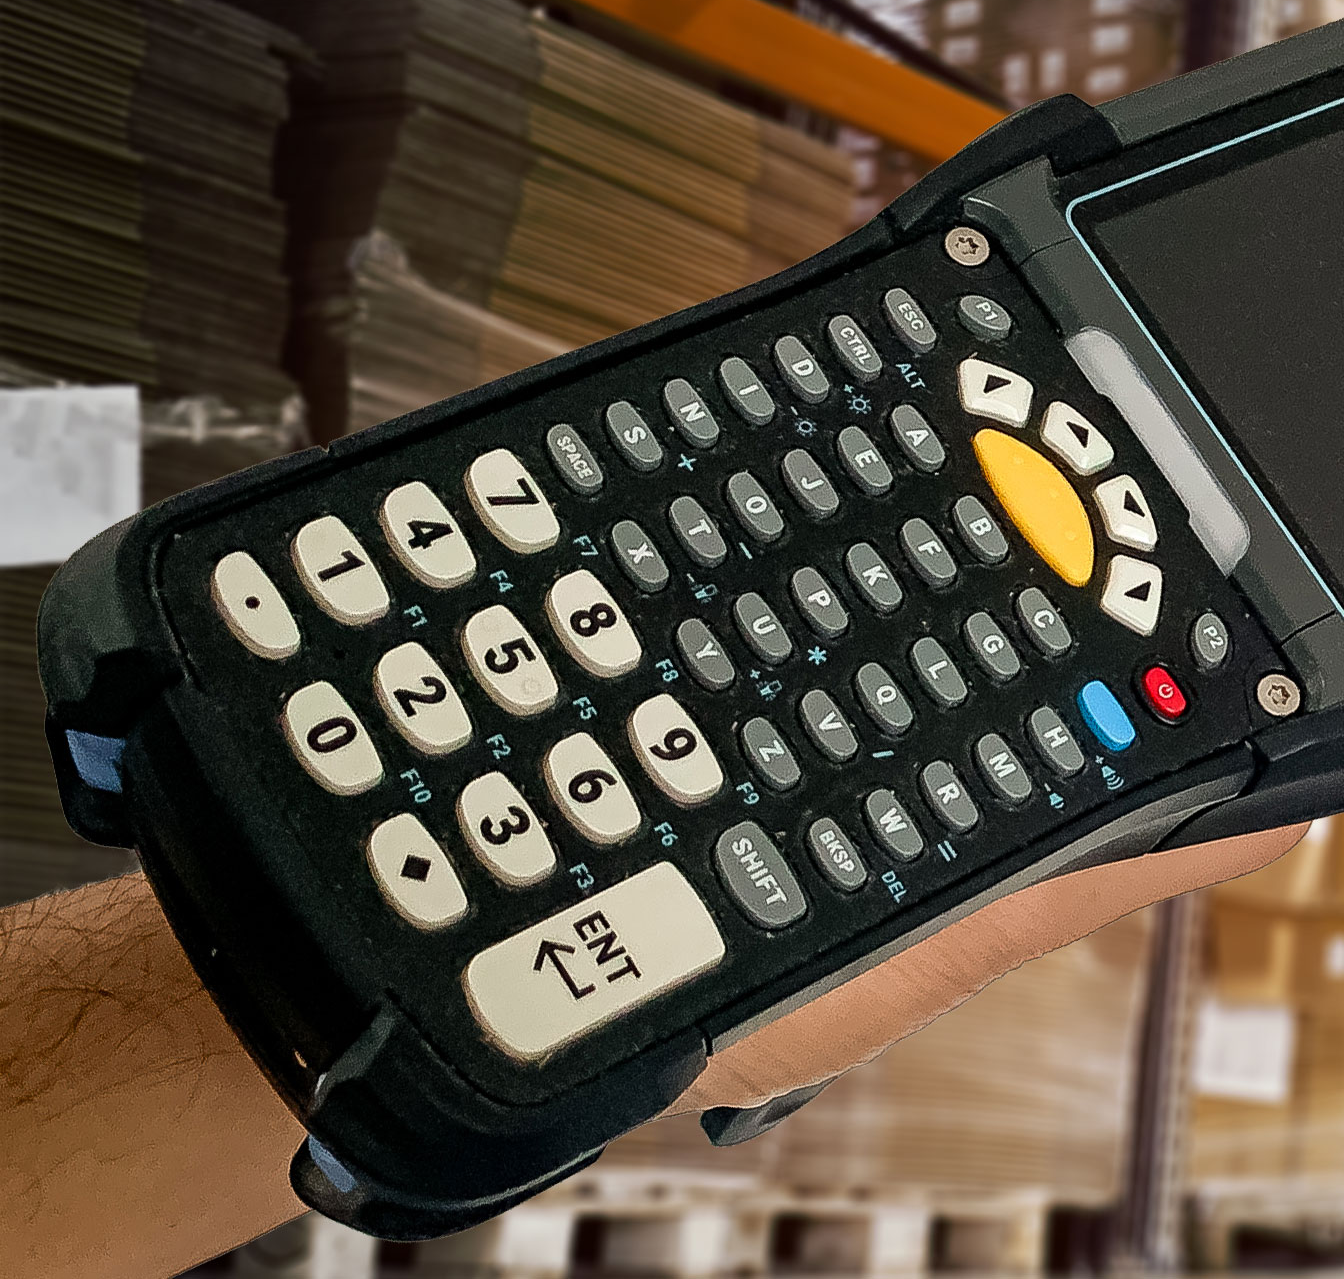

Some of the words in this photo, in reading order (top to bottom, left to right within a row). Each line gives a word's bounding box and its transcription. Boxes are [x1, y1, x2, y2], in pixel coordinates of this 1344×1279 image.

[896, 301, 925, 332] ESC
[974, 300, 999, 322] P1
[838, 325, 872, 365] CTRL
[790, 358, 814, 376] D
[895, 362, 926, 390] ALT
[679, 402, 706, 423] N
[623, 425, 648, 445] S
[905, 427, 931, 447] A
[555, 434, 595, 481] SPACE
[854, 446, 880, 469] E
[486, 477, 539, 507] 7
[800, 477, 825, 490] J
[407, 518, 454, 550] 4
[687, 516, 712, 537] T
[969, 517, 992, 536] B
[572, 534, 599, 556] F7
[627, 542, 654, 564] X
[917, 539, 944, 557] F
[318, 549, 366, 582] 1
[861, 564, 889, 587] K
[489, 569, 514, 593] F4
[807, 588, 833, 608] P
[403, 604, 428, 628] F1
[569, 601, 618, 638] 8
[749, 616, 777, 638] U
[1033, 609, 1055, 629] C
[982, 633, 1005, 655] G
[1202, 626, 1226, 650] P2
[484, 636, 537, 675] 5
[695, 641, 720, 660] Y
[655, 658, 679, 683] F8
[927, 660, 948, 680] L
[392, 675, 447, 718] 2
[875, 685, 897, 706] Q
[572, 696, 598, 720] F5
[306, 715, 358, 753] 0
[817, 712, 842, 733] V
[486, 733, 512, 760] F2
[648, 726, 698, 762] 9
[1043, 726, 1069, 749] H
[758, 740, 787, 764] Z
[988, 752, 1017, 780] M
[399, 767, 432, 804] F10
[568, 768, 618, 804] 6
[735, 781, 760, 805] F9
[936, 782, 961, 805] R
[479, 804, 531, 846] 3
[879, 807, 908, 834] W
[653, 821, 679, 847] F6
[819, 829, 854, 873] BKSP
[568, 862, 595, 890] F3
[731, 836, 789, 908] SHIFT
[881, 870, 907, 904] DEL
[572, 909, 642, 984] ENT
